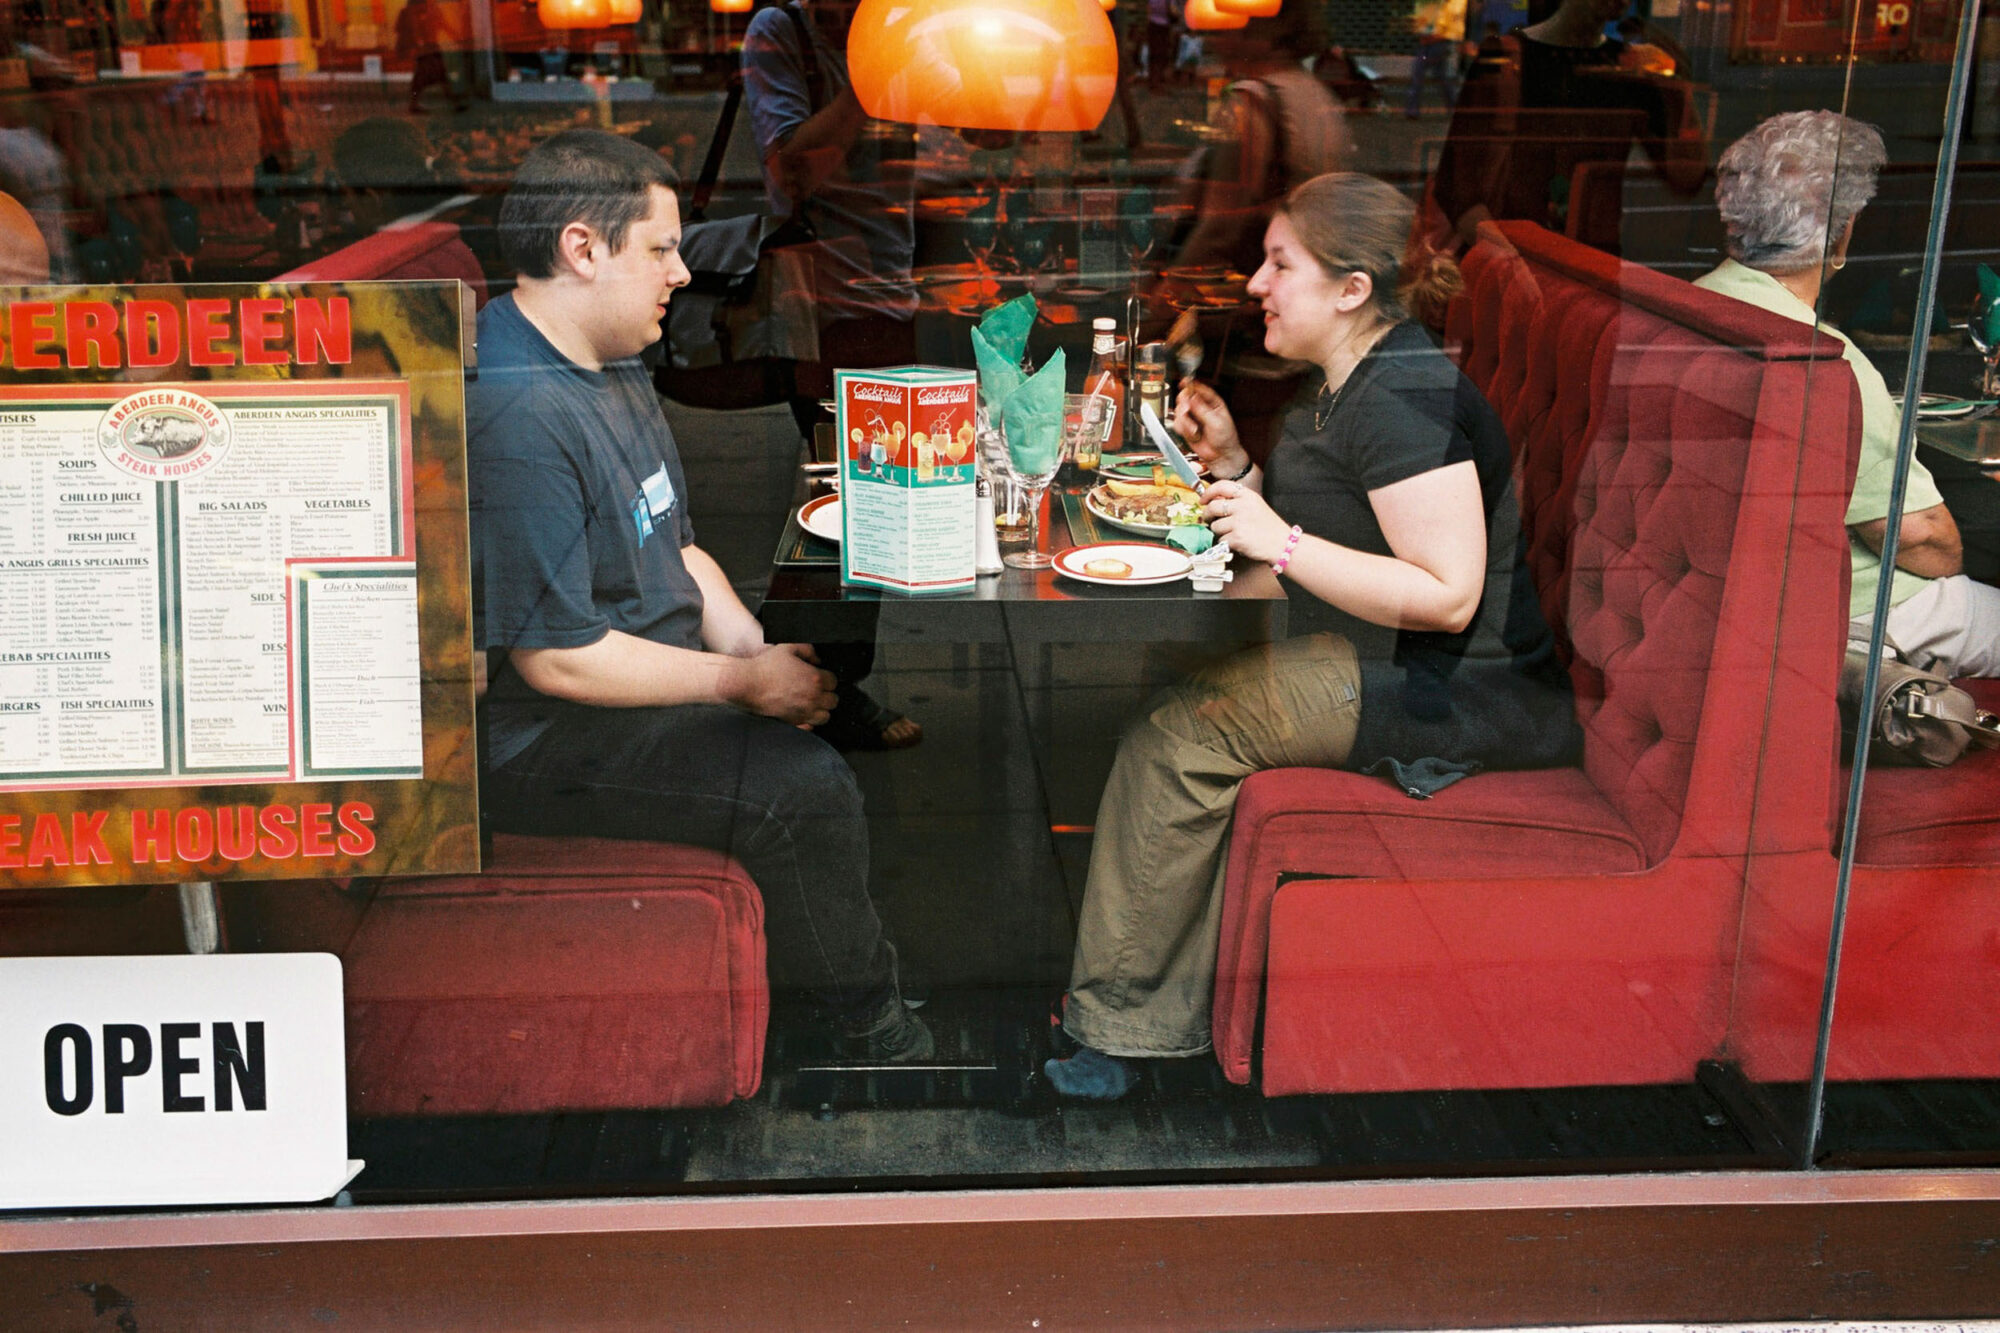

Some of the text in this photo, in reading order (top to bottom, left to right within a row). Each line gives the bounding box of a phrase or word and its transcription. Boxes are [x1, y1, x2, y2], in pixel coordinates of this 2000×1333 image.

[0, 297, 351, 369] ERDEEN
[853, 383, 902, 398] Cocktails
[917, 386, 970, 400] Cocktails
[109, 394, 219, 429] ABERDEEN ANGUS
[234, 410, 377, 419] ABERDEEN ANGUS SPECIALITIES
[58, 460, 97, 468] SOUPS
[118, 453, 157, 475] STEAK
[164, 452, 212, 475] HOUSES
[60, 492, 142, 503] CHILLED JUICE
[199, 502, 267, 511] BIG SALADS
[305, 500, 371, 509] VEGETABLES
[68, 532, 137, 542] FRESH JUICE
[8, 559, 44, 568] ANGUS
[47, 558, 81, 567] GRILLS
[84, 558, 149, 567] SPECIALITIES
[323, 581, 408, 592] Chef's Specialities
[250, 593, 274, 602] SIDE
[36, 651, 111, 661] SPECIALITIES
[61, 699, 154, 710] FISH SPECIALITIES
[131, 801, 376, 864] HOUSES
[44, 1021, 267, 1116] OPEN
